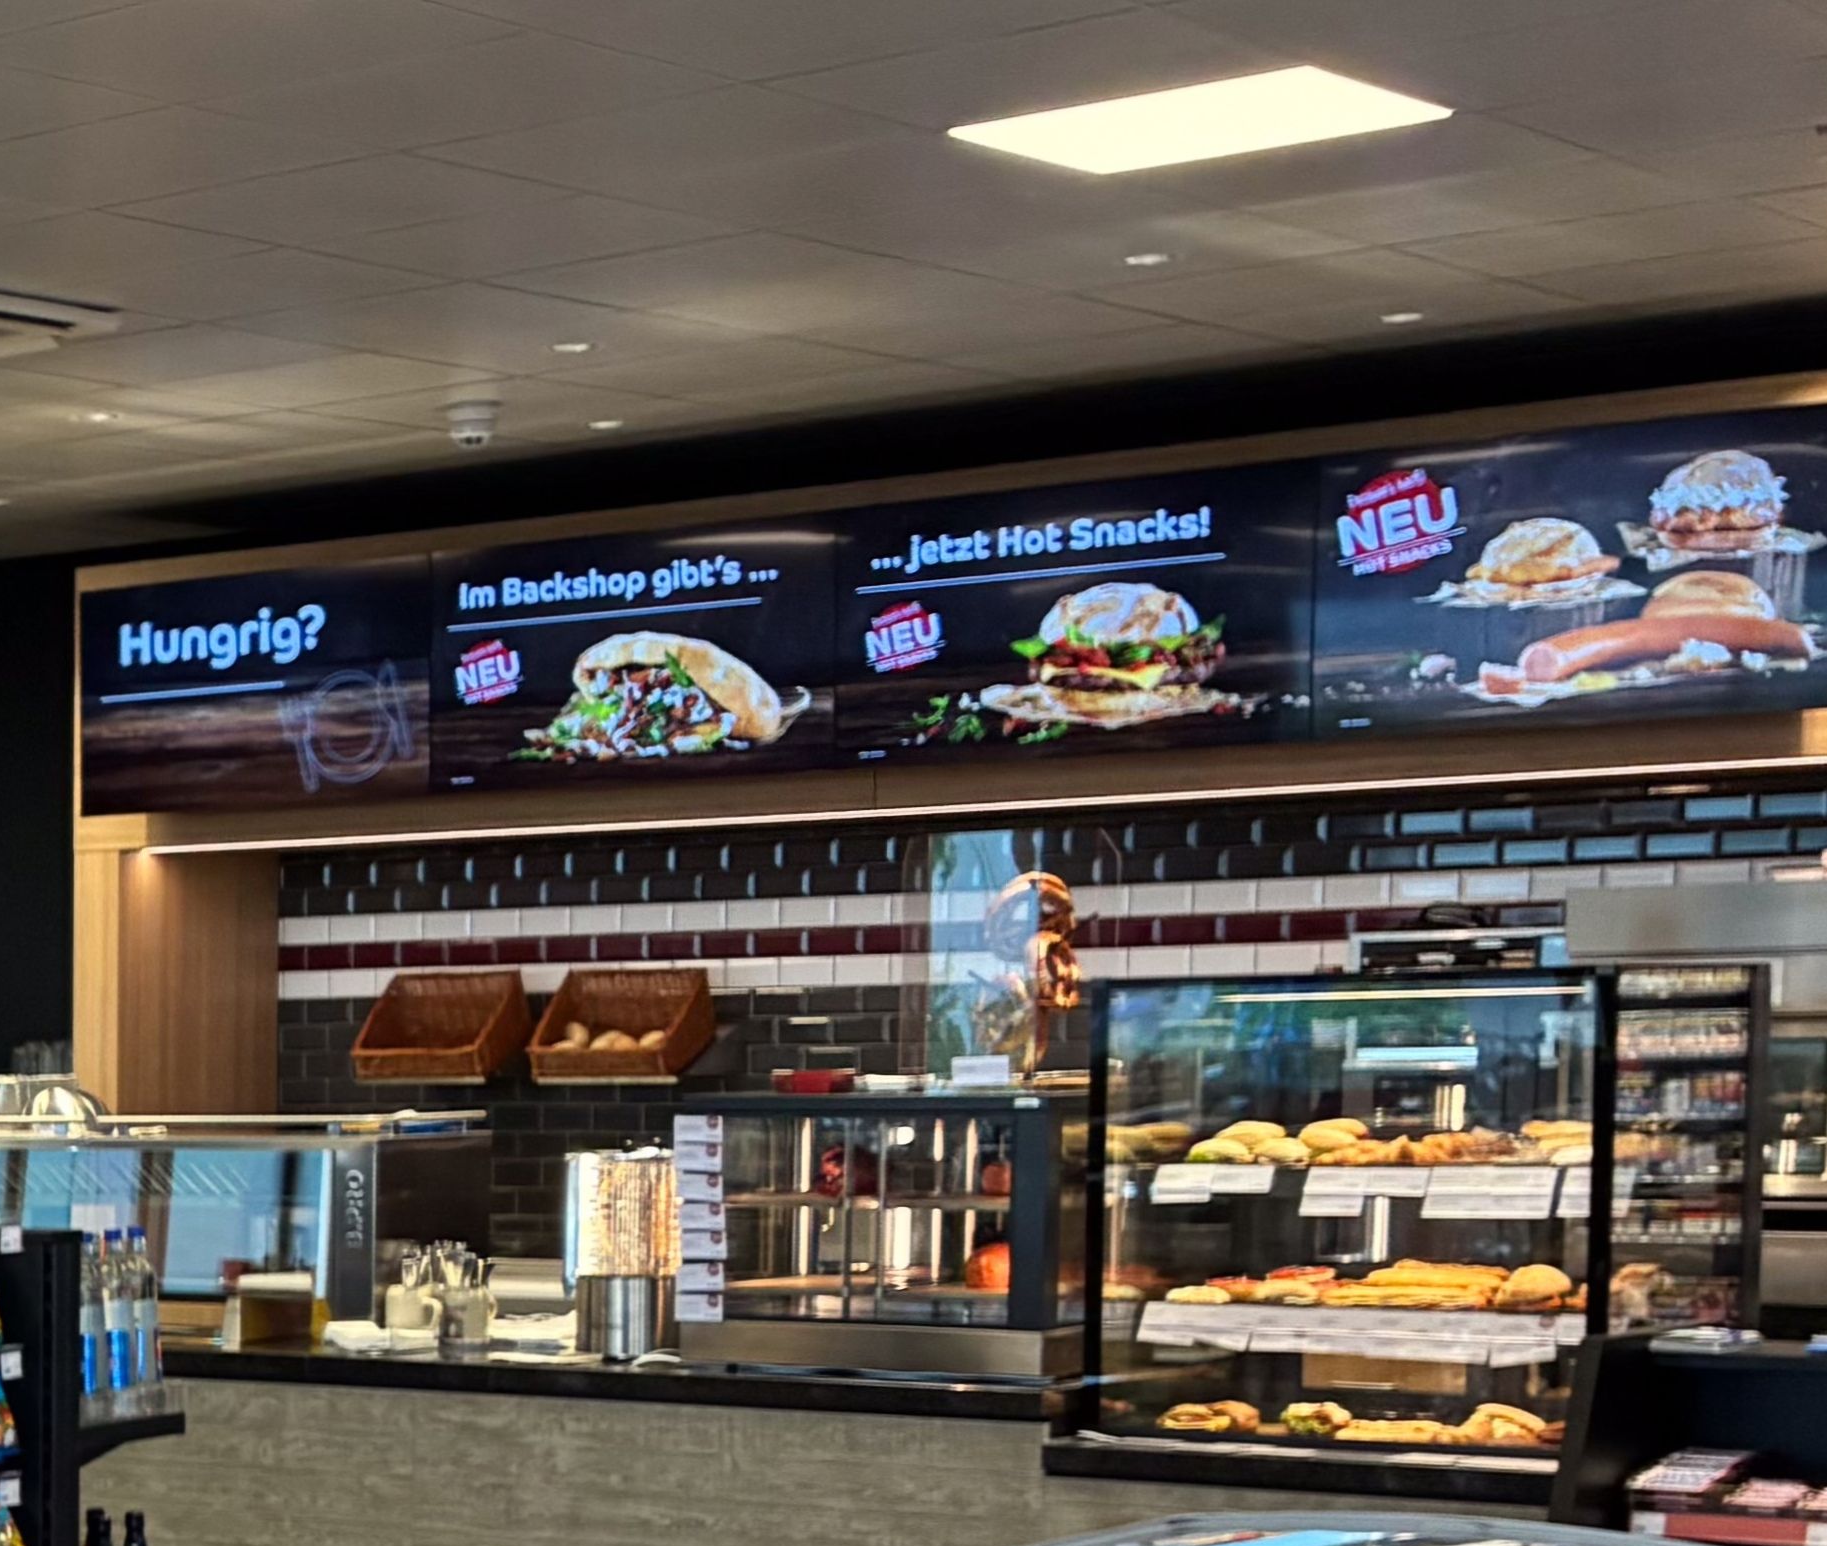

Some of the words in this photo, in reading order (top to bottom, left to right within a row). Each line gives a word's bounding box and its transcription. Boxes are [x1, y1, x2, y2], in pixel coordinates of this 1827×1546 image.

[905, 531, 990, 574] jetzt
[998, 523, 1063, 558] Hot
[1069, 506, 1211, 550] Snacks!
[1337, 487, 1457, 557] NEU
[459, 583, 496, 609] Im
[502, 568, 645, 606] Backshop
[652, 557, 742, 600] gibt's
[119, 604, 326, 669] Hungrig?
[865, 612, 942, 660] NEU
[455, 650, 521, 696] NEU
